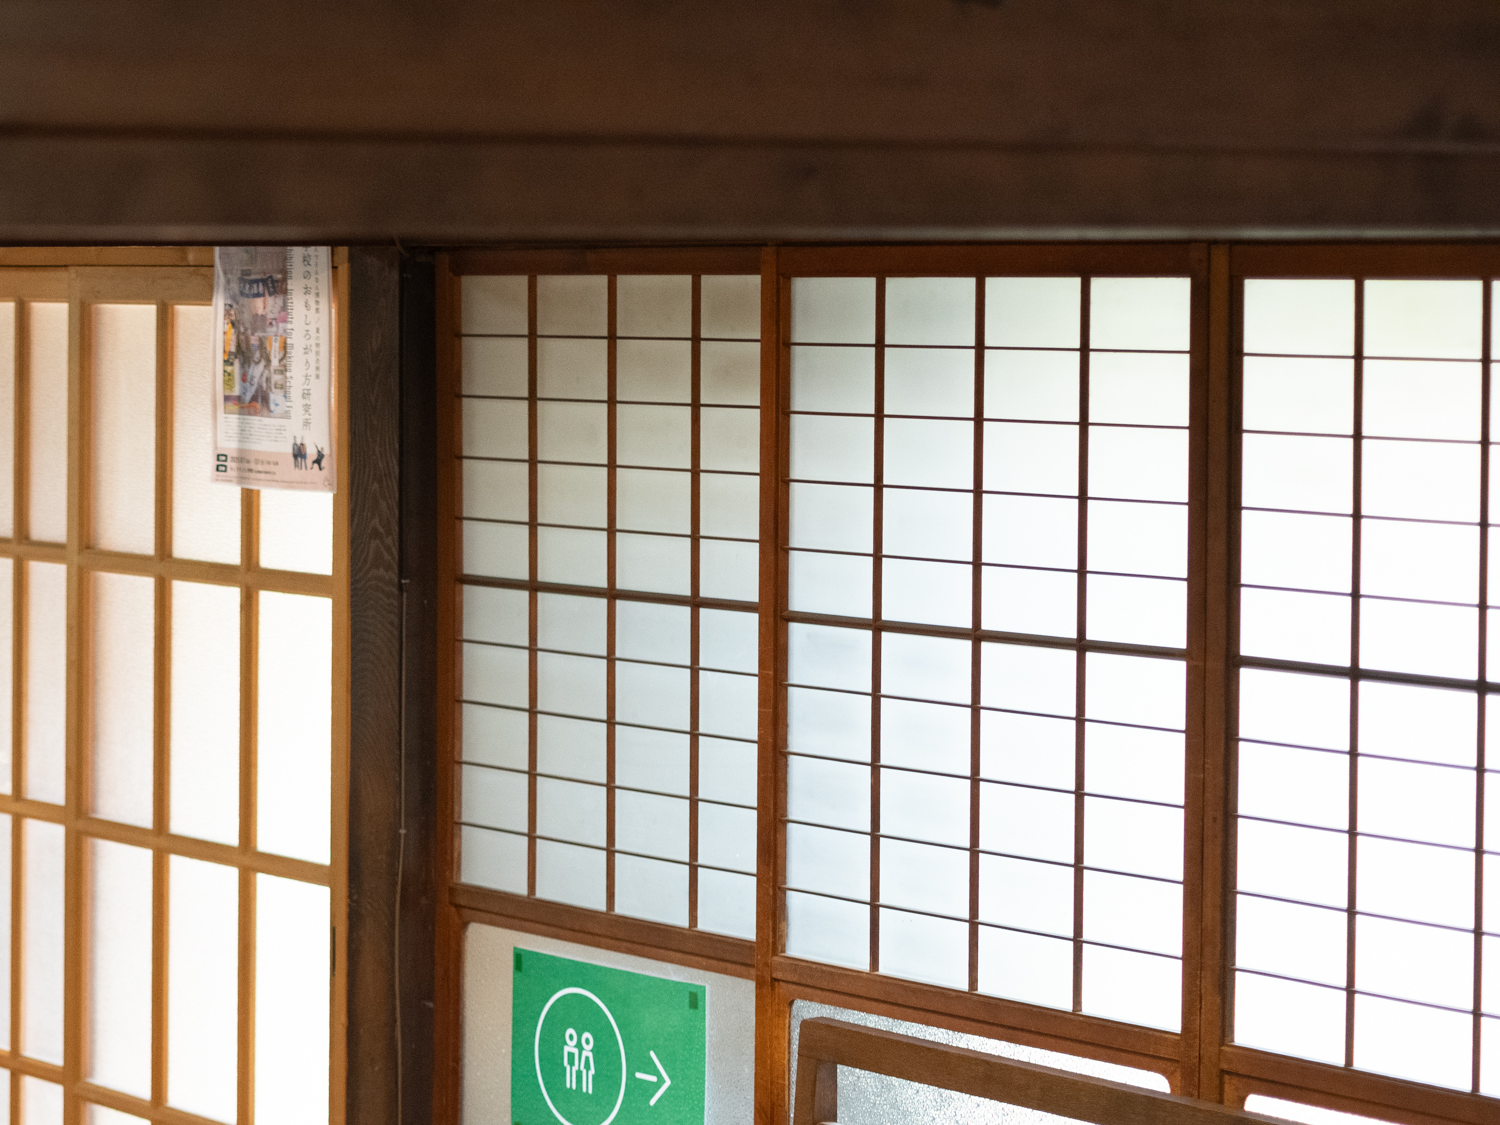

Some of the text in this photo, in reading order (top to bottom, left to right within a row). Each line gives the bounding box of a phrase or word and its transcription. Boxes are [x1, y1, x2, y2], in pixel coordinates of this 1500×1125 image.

[302, 247, 312, 430] 校のおもしろがり方研究所
